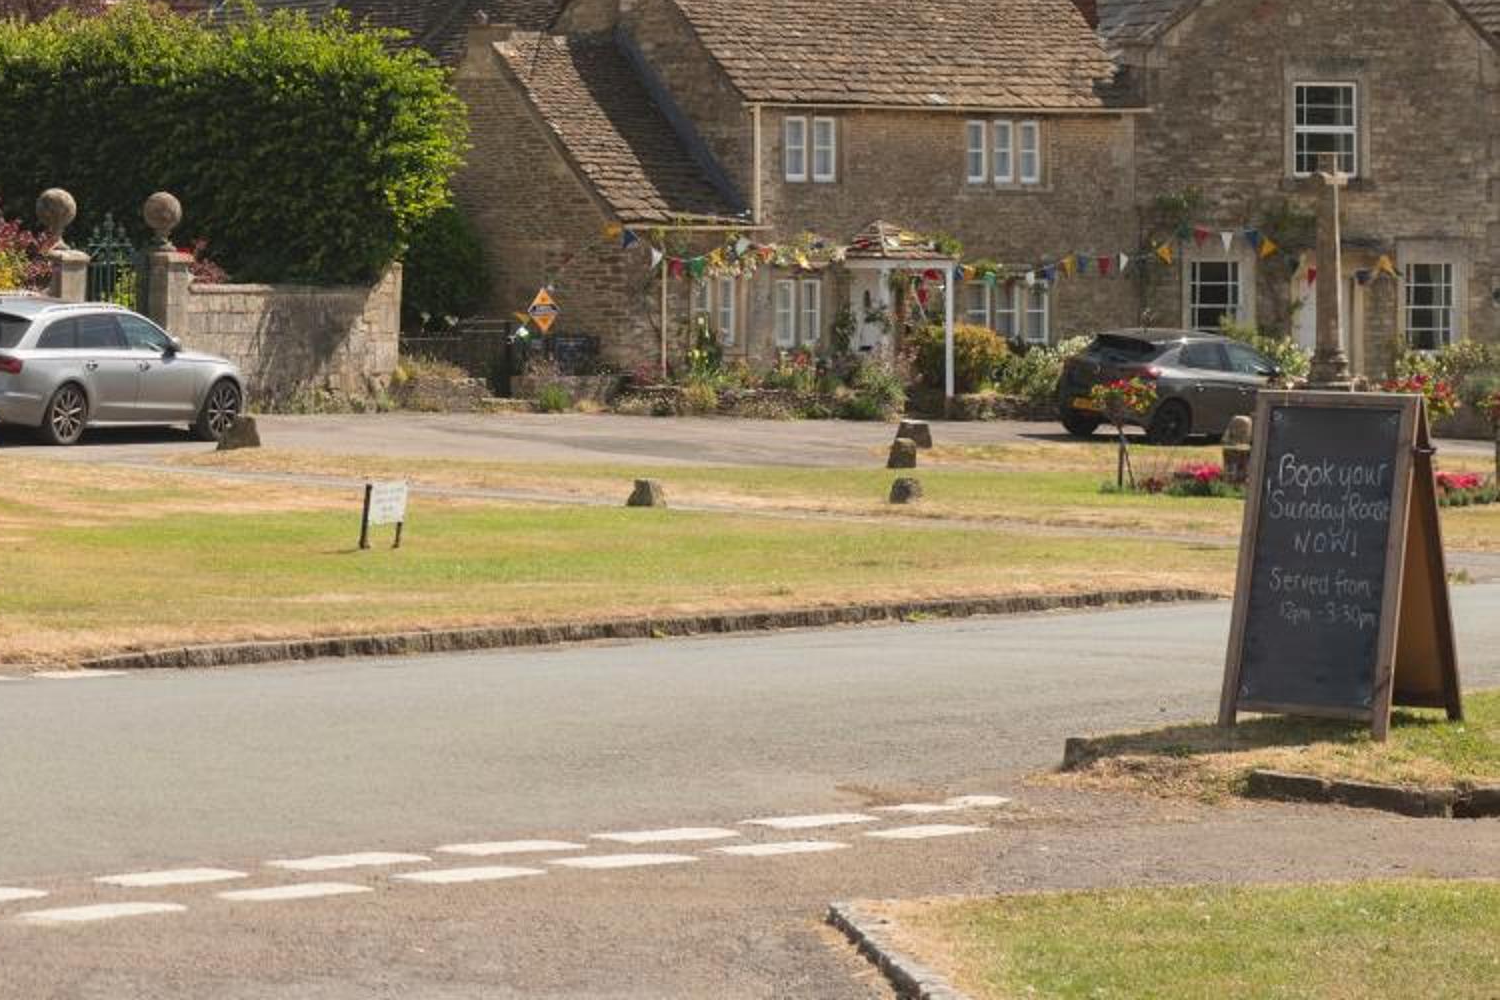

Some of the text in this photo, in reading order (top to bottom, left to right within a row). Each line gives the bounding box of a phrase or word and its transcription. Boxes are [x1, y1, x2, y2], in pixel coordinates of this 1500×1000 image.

[1279, 453, 1387, 499] Book your
[1269, 490, 1389, 534] Sunday Roast
[1269, 567, 1372, 596] Served from
